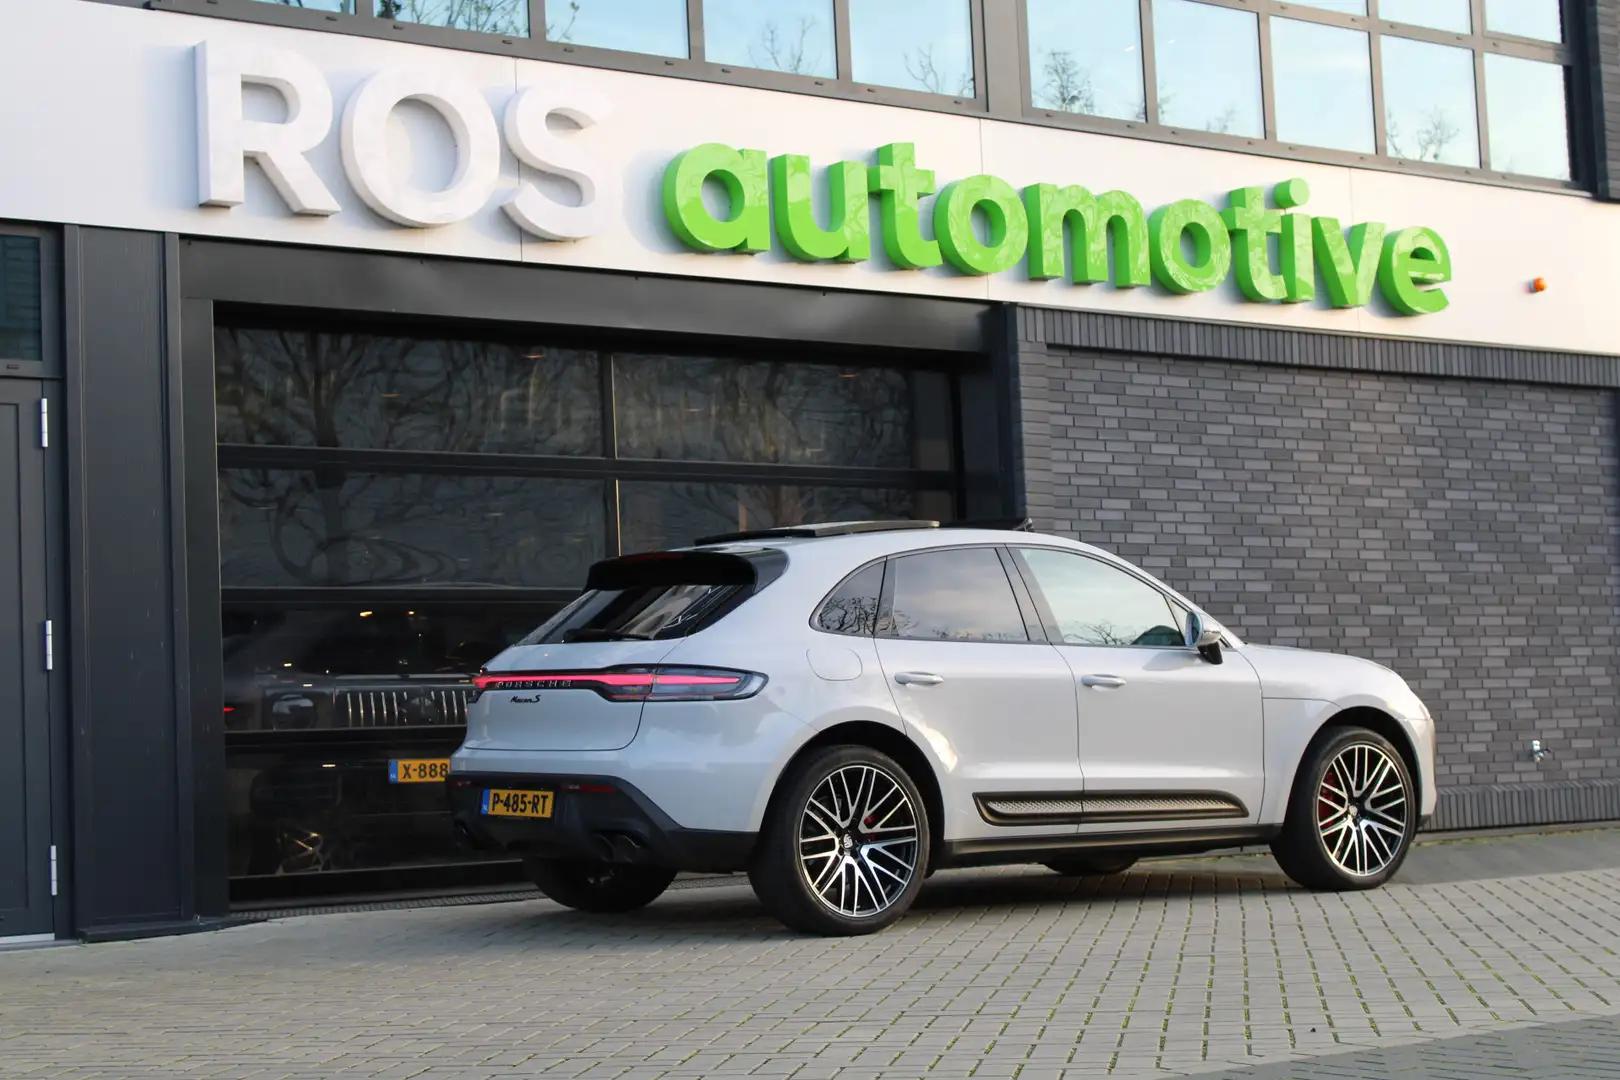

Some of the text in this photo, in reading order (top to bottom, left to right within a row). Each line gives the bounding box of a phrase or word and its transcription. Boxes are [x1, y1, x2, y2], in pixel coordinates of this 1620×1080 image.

[194, 38, 1452, 316] ROS automotive
[491, 792, 549, 814] P-485-RT
